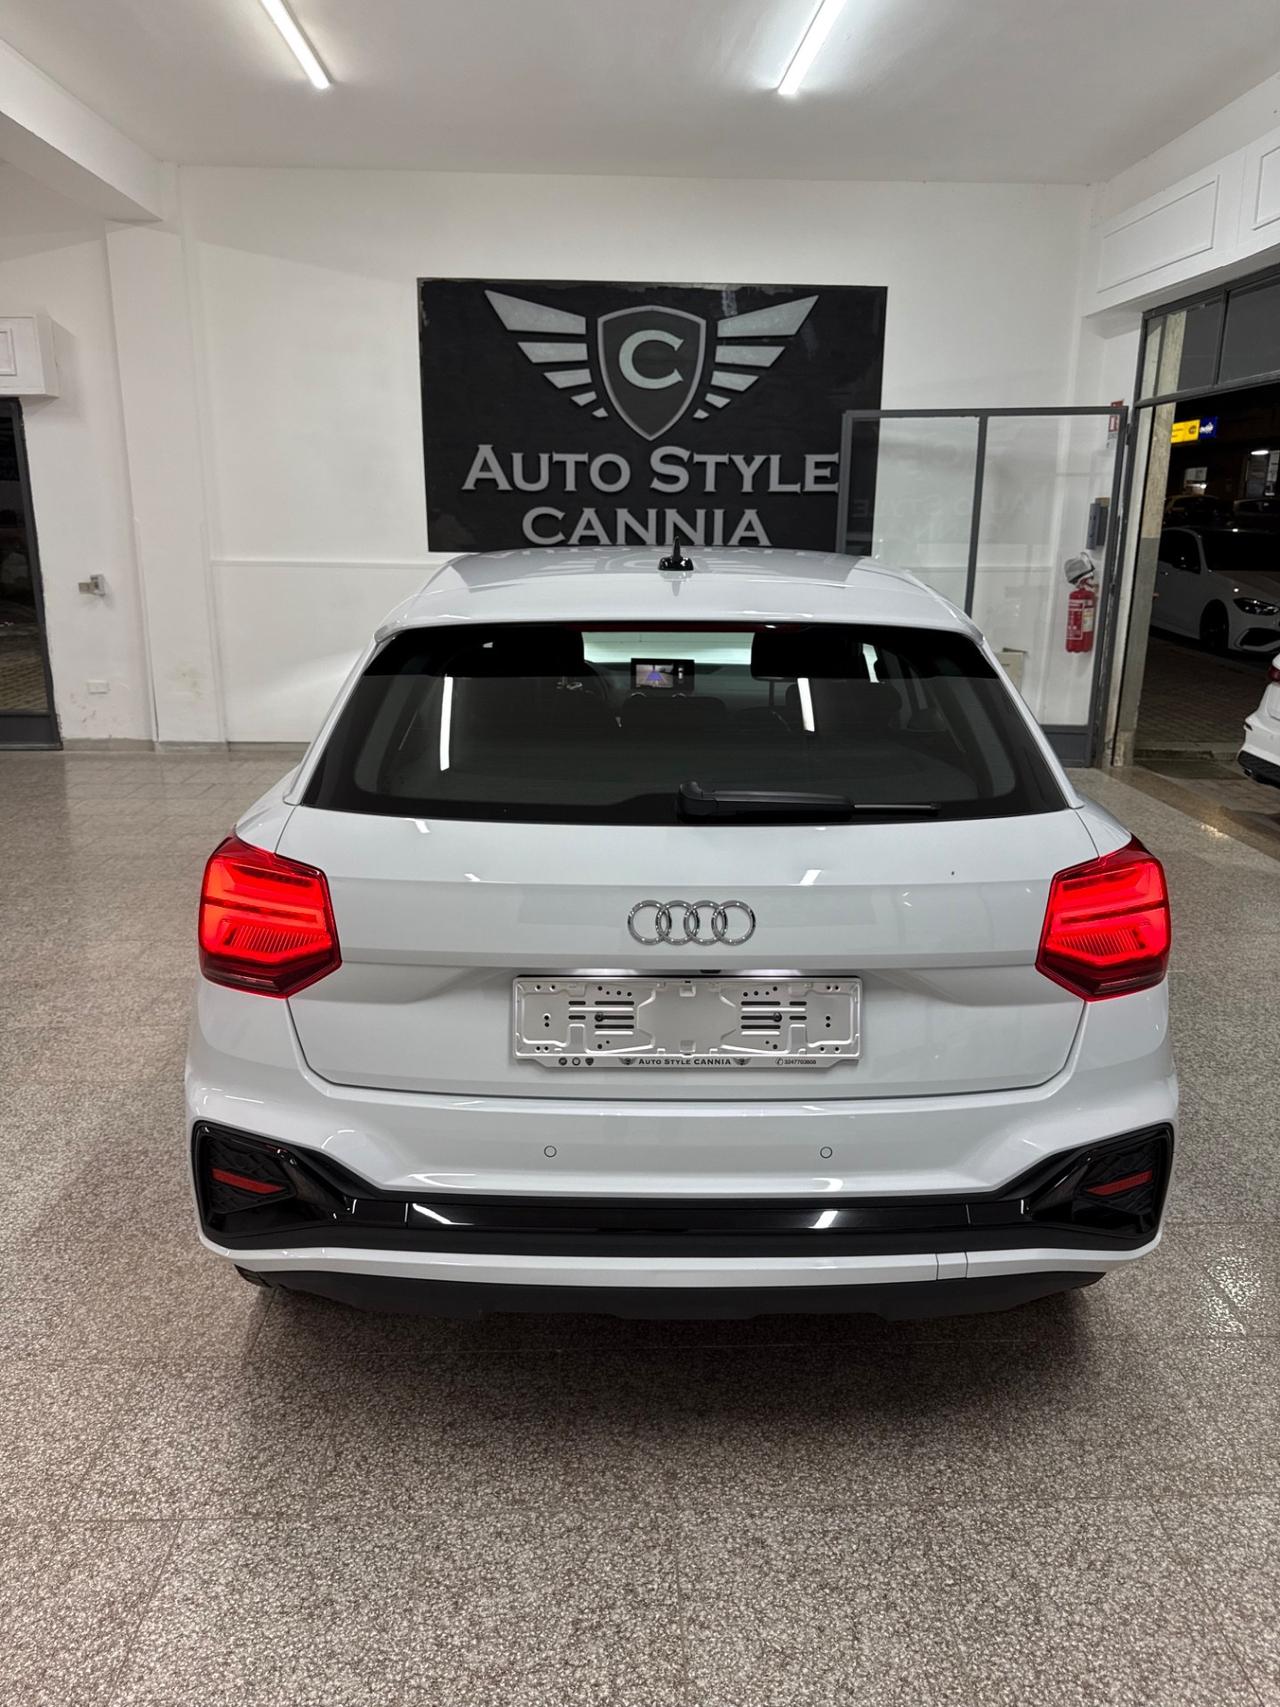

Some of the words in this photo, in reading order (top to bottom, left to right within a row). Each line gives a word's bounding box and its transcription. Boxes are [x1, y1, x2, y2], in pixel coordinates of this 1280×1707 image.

[619, 329, 684, 389] C
[462, 444, 631, 493] AUTO
[650, 446, 839, 494] STYLE
[521, 507, 771, 546] CANNIA
